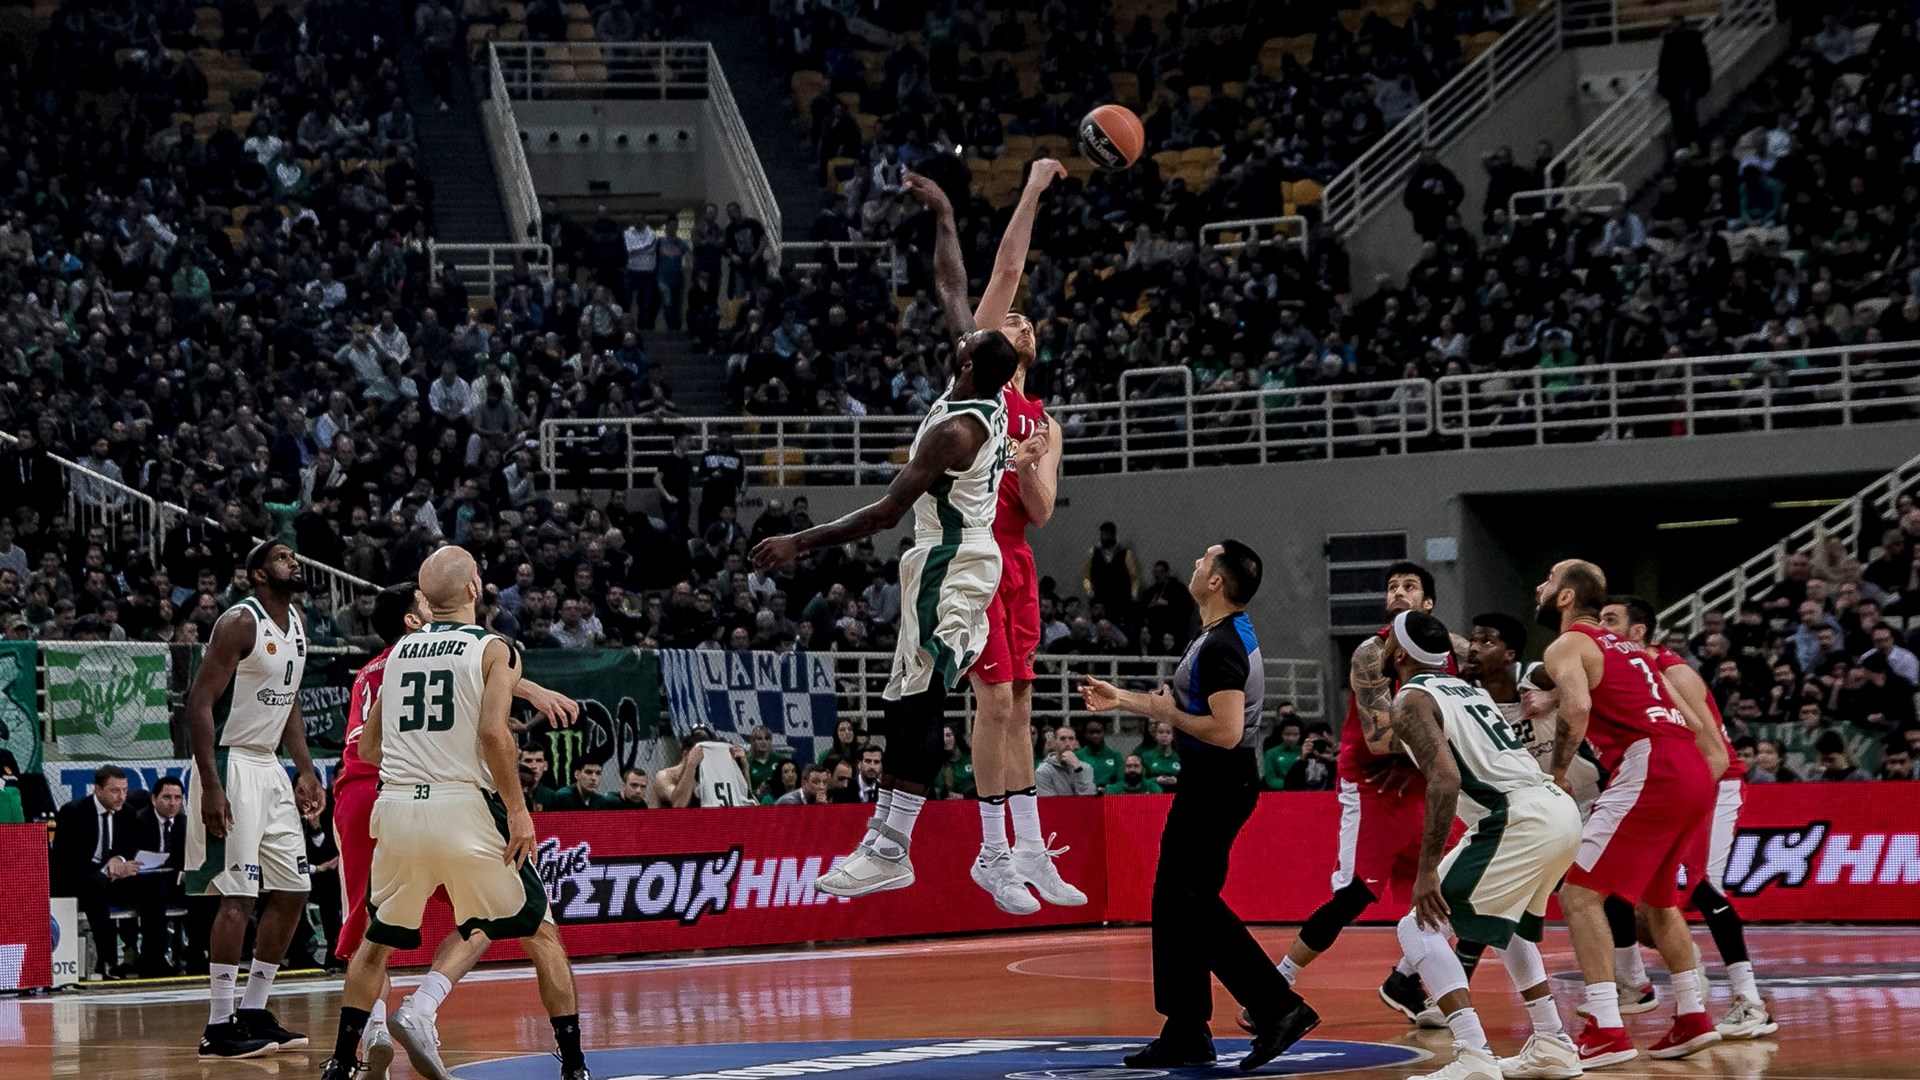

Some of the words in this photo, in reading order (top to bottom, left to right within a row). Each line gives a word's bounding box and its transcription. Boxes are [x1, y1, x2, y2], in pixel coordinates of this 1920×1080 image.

[398, 640, 468, 659] ΚΑΛΑΘΗΣ
[284, 660, 293, 686] 0
[702, 651, 831, 690] LAMIA
[1629, 657, 1663, 701] 7
[399, 669, 455, 732] 33
[1464, 703, 1524, 752] 12
[414, 784, 431, 800] 33
